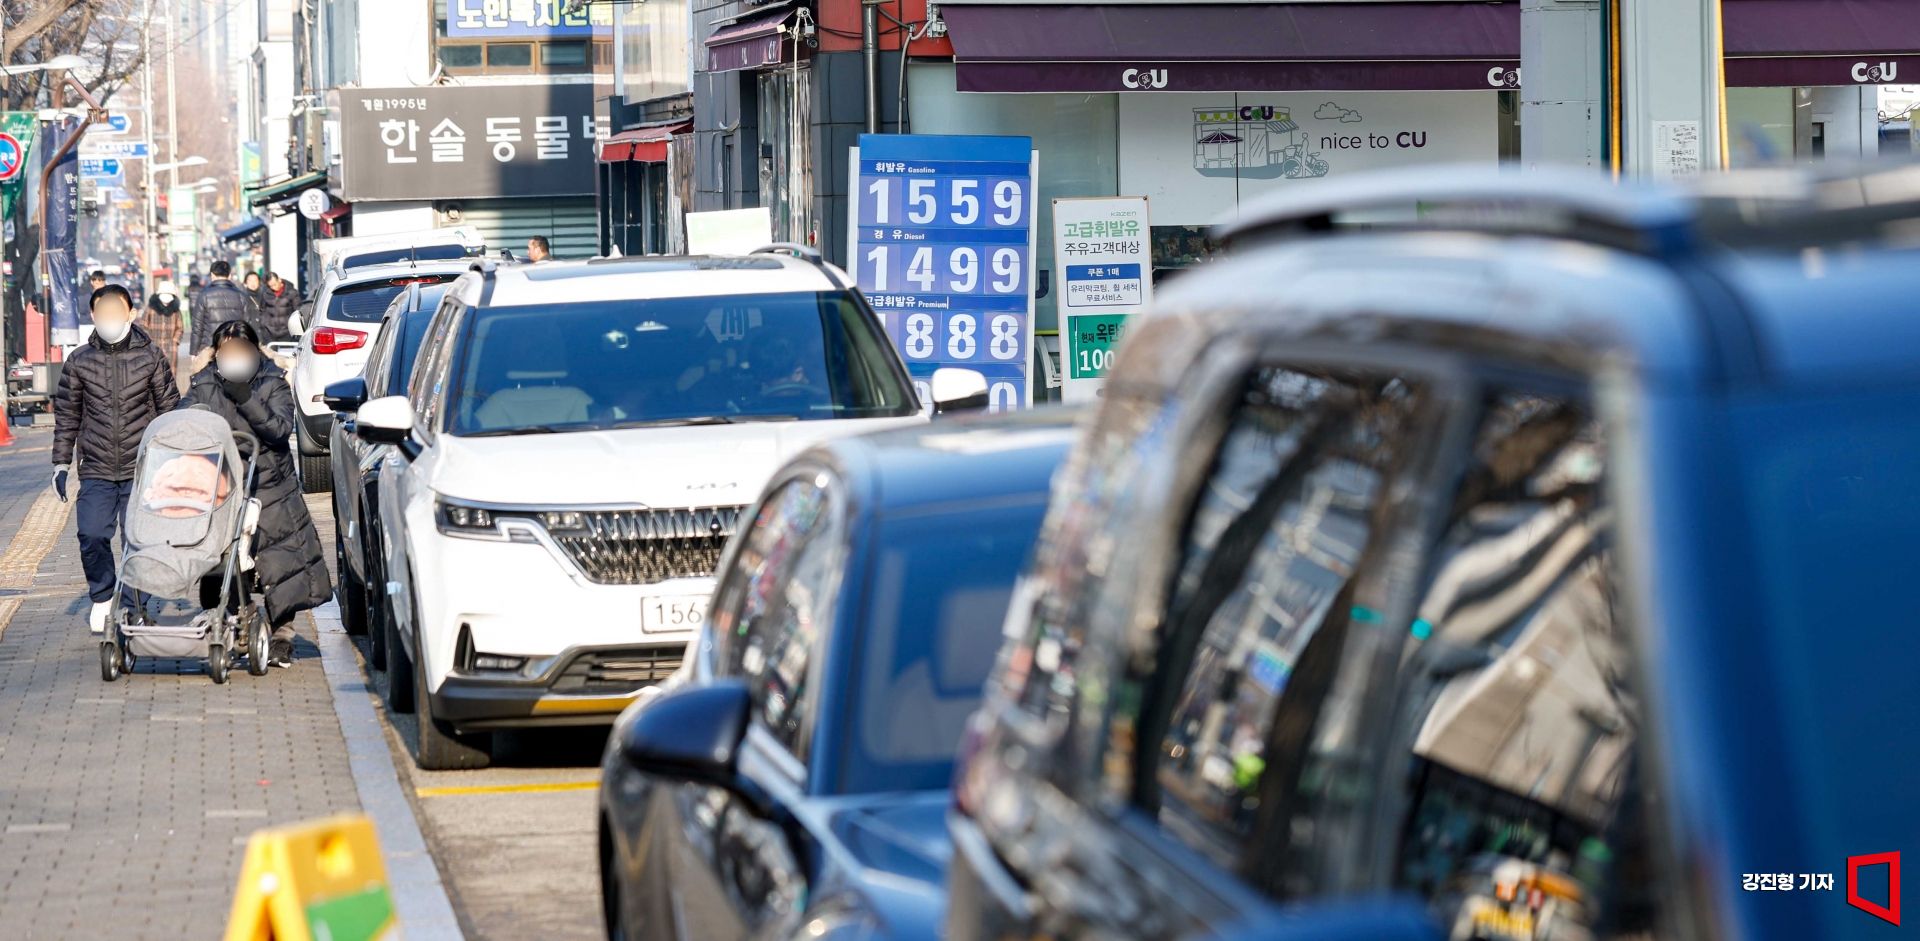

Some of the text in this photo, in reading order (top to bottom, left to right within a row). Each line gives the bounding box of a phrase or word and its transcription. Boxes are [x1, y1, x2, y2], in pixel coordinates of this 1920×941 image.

[1122, 68, 1168, 89] CU
[1851, 62, 1897, 83] CU
[1240, 105, 1274, 121] CU
[379, 117, 466, 164] 한솔
[1321, 131, 1427, 150] nice to CU
[875, 162, 906, 173] 휘발유
[869, 178, 1022, 225] 1559
[1064, 220, 1140, 238] 고급휘발유
[1065, 241, 1141, 256] 주유고객대상
[867, 246, 1021, 294] 1499
[1087, 267, 1104, 277] 쿠폰
[866, 295, 916, 307] 고급휘발유
[1086, 293, 1124, 302] 무료서비스
